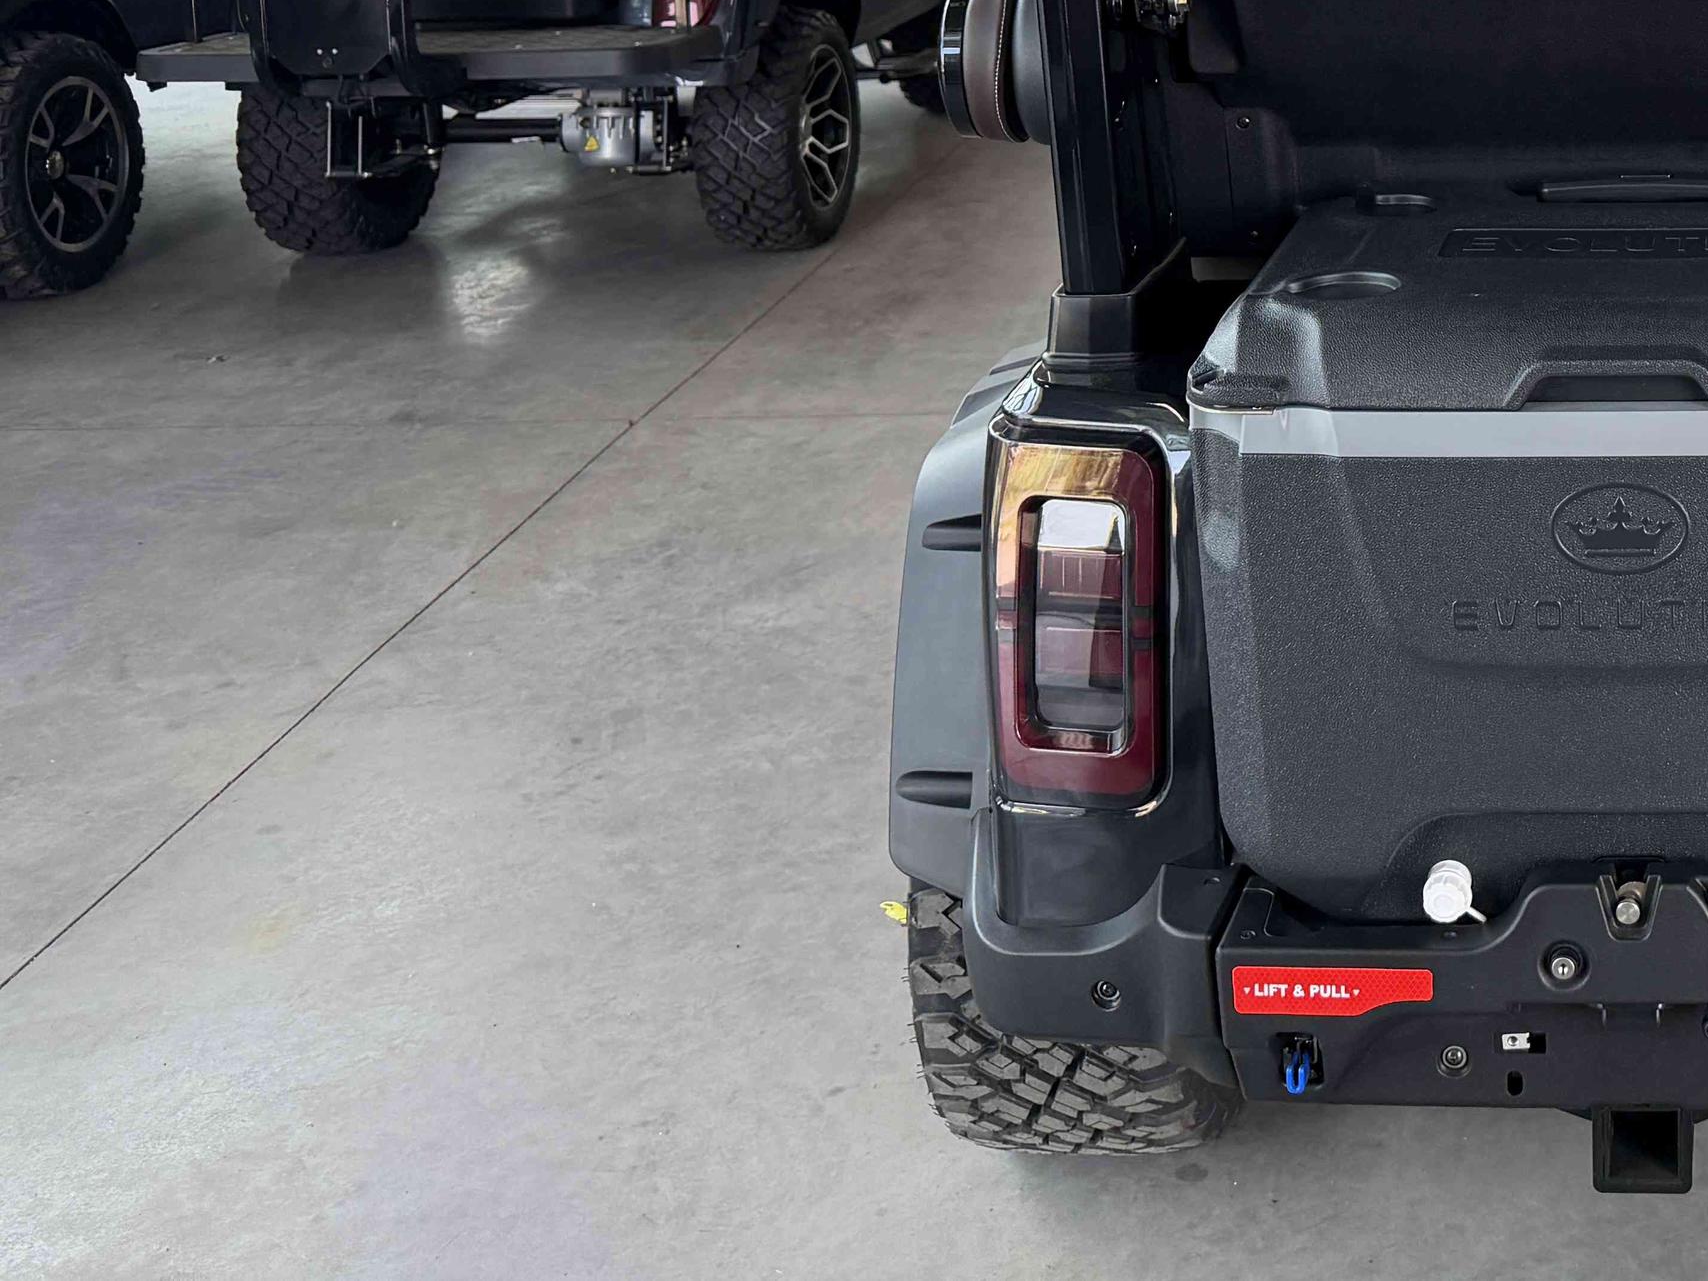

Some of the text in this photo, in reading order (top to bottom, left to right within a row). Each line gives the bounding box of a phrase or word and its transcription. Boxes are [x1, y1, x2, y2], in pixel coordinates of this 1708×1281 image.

[1254, 983, 1350, 998] LIFT & PULL
